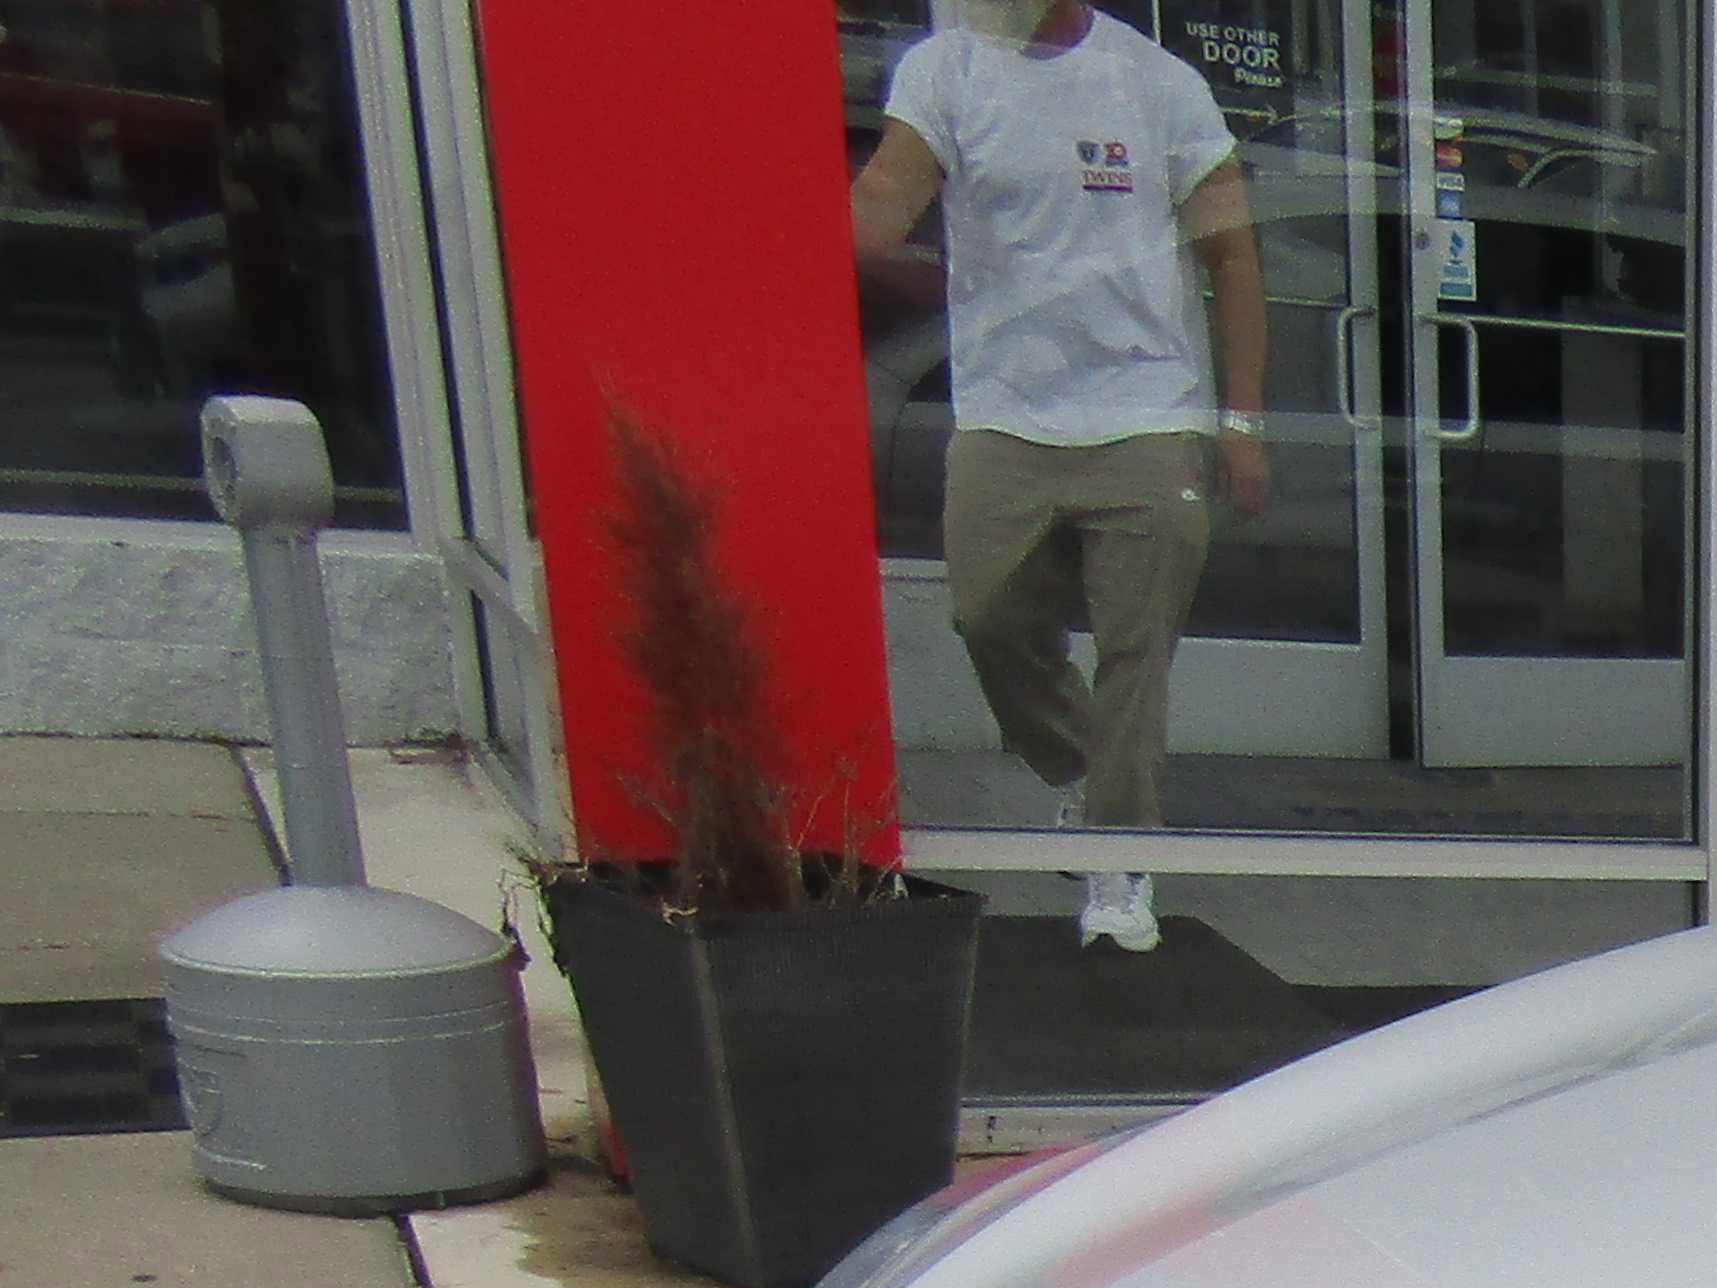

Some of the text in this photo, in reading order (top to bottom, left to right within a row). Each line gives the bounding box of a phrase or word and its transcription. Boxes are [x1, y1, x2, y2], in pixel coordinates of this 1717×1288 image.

[1185, 21, 1280, 46] USE OTHER
[1202, 40, 1280, 70] DOOR
